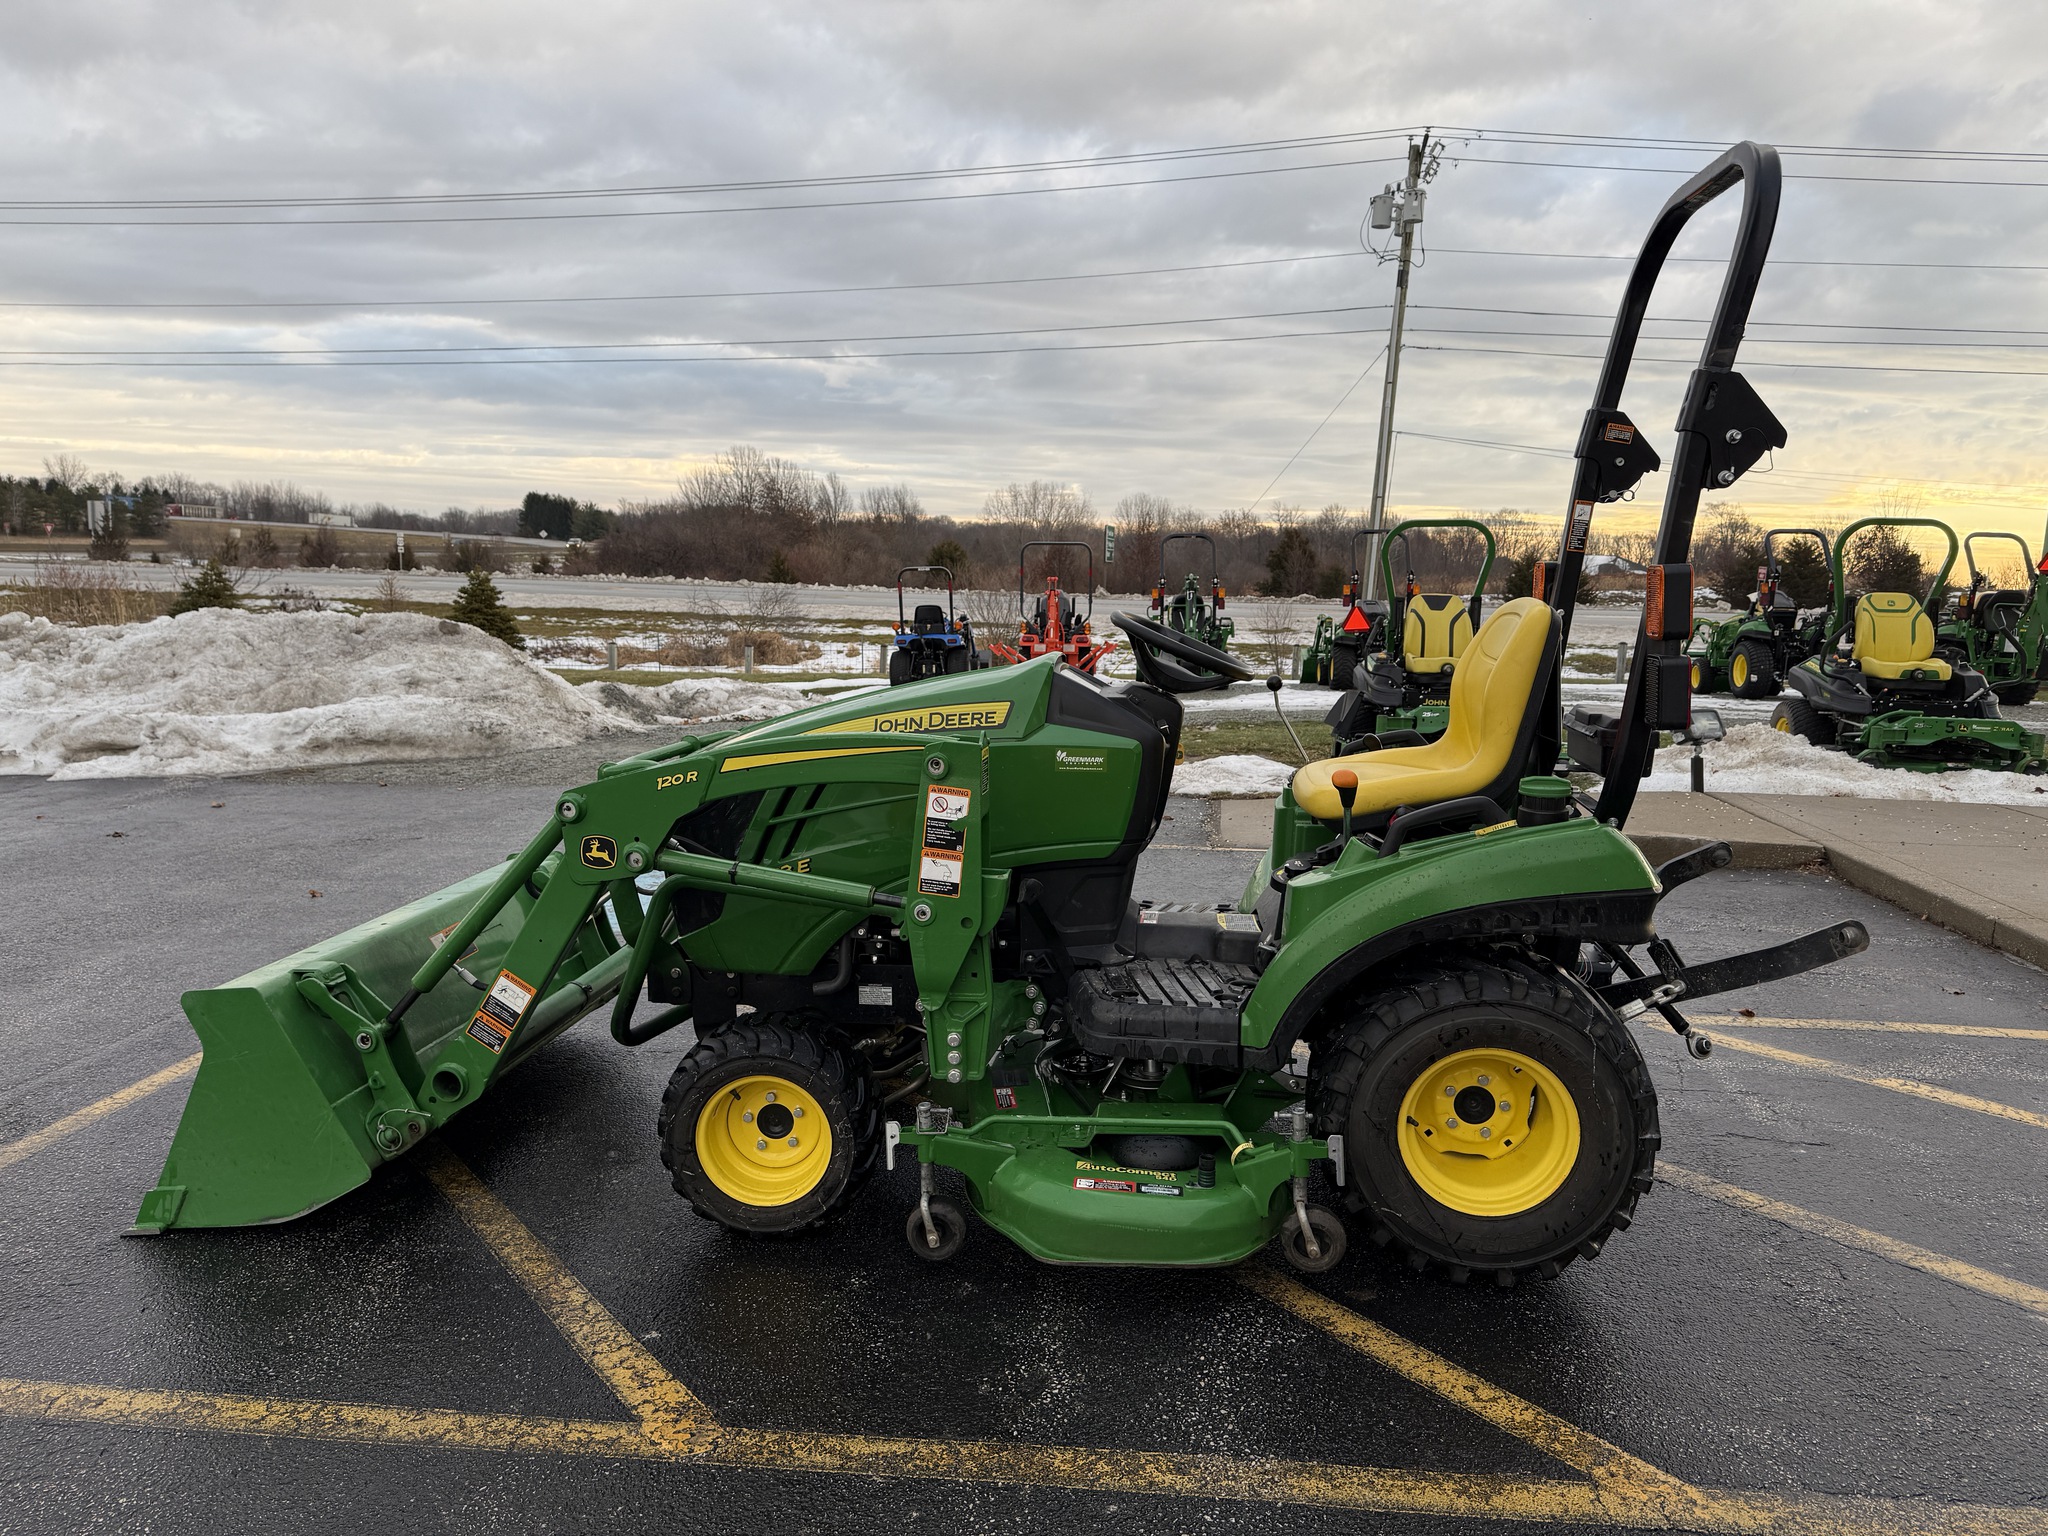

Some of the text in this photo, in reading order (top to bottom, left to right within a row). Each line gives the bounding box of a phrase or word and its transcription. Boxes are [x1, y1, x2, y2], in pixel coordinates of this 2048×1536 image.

[873, 711, 997, 733] JOHN DEERE
[1945, 721, 1956, 733] 5
[937, 787, 969, 797] WARNING
[930, 851, 962, 861] WARNING
[510, 976, 532, 993] WARNING
[485, 1018, 507, 1035] WARNING
